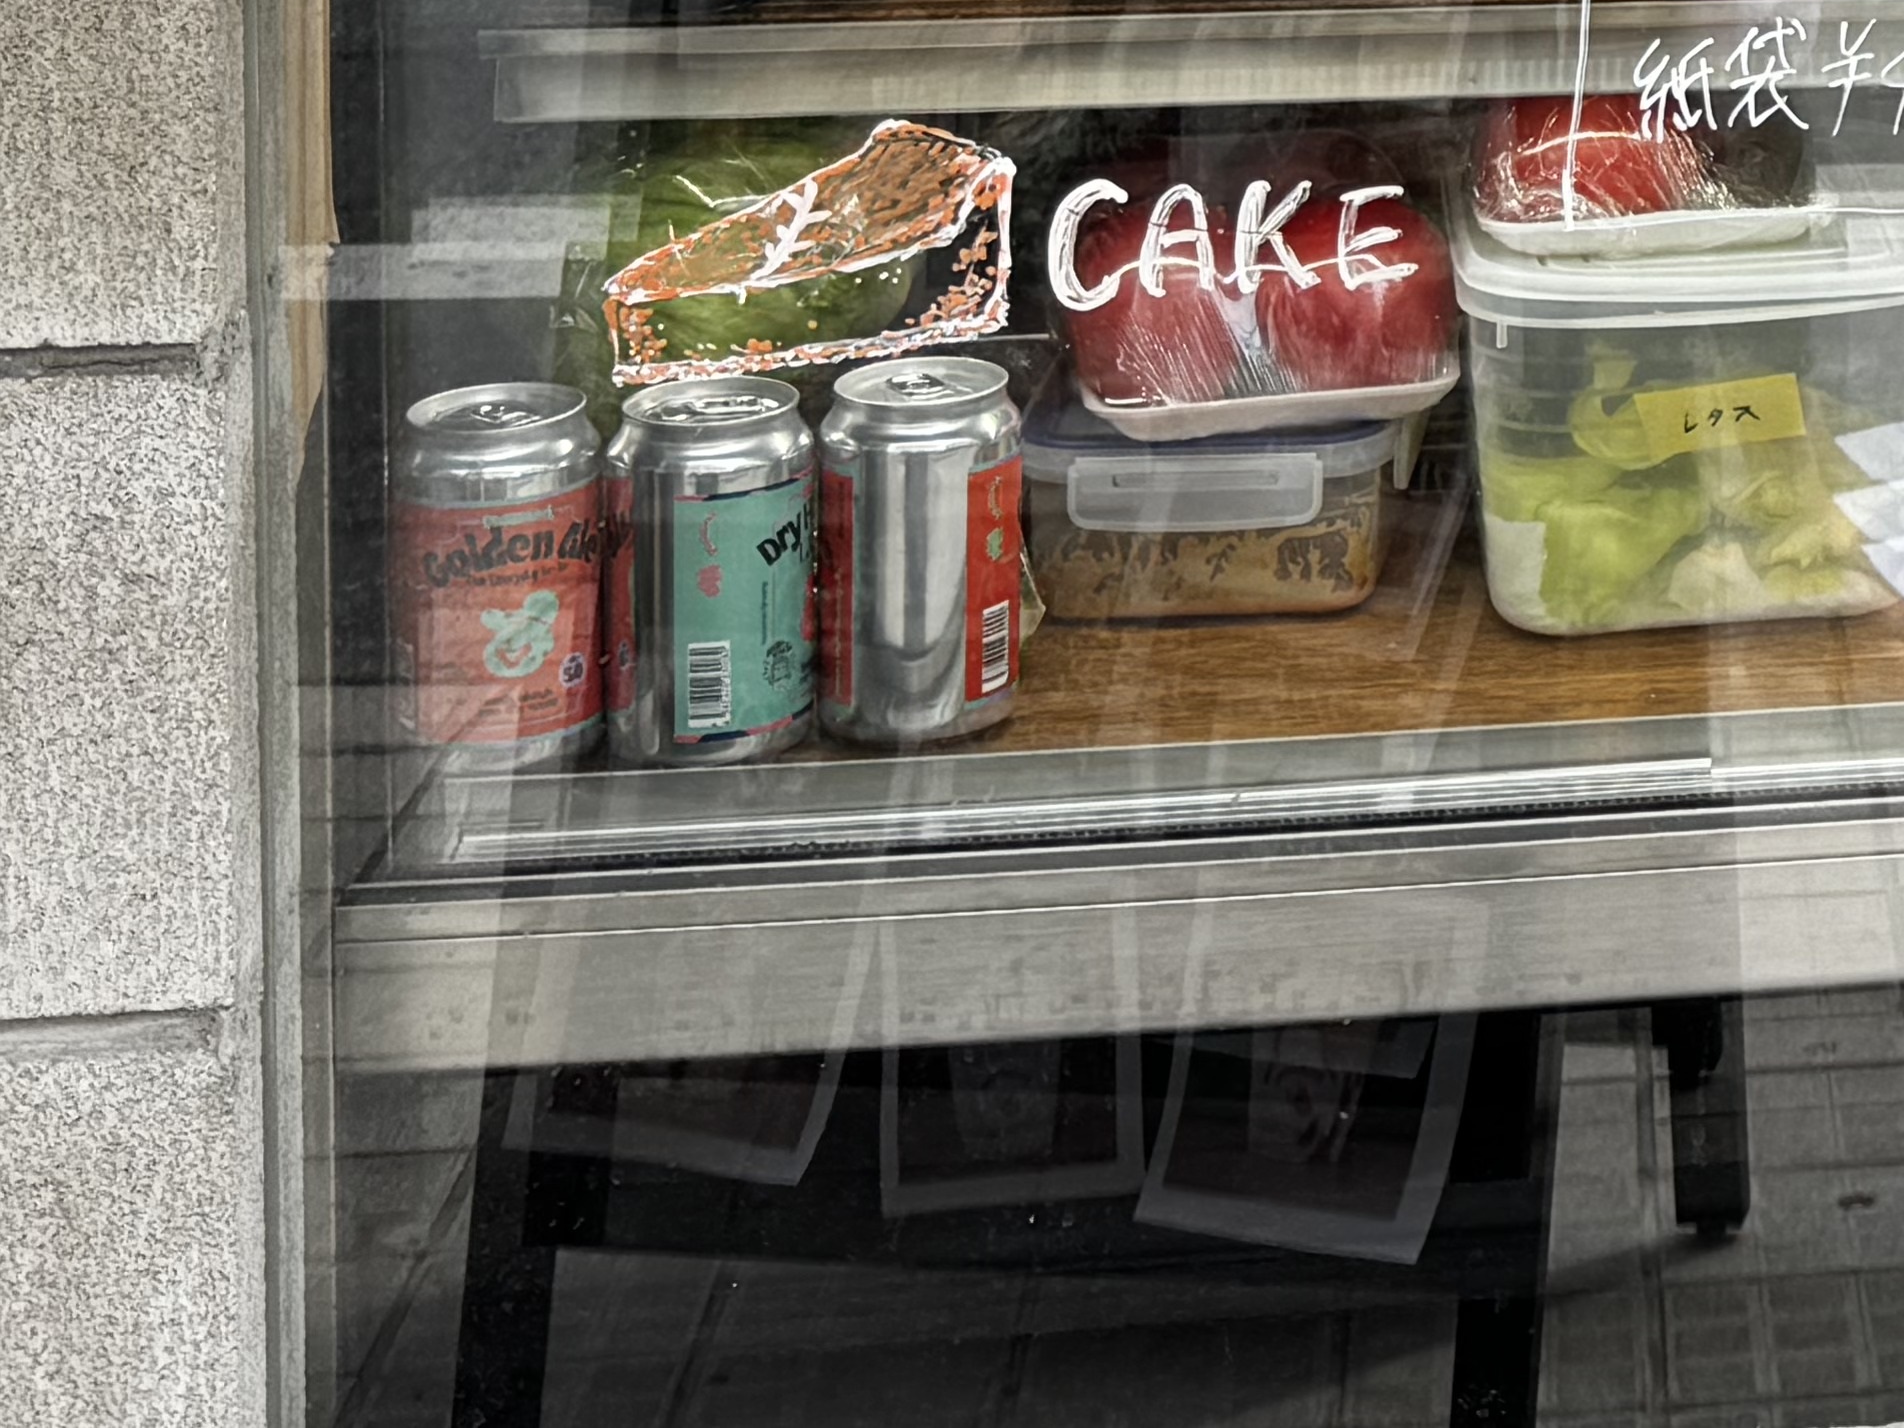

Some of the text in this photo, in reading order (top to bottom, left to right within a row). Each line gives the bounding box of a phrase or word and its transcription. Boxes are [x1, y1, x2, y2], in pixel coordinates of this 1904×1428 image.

[1633, 18, 1808, 144] 紙袋
[1048, 178, 1419, 312] CAKE
[1683, 402, 1760, 434] レタス
[422, 527, 553, 587] Golden
